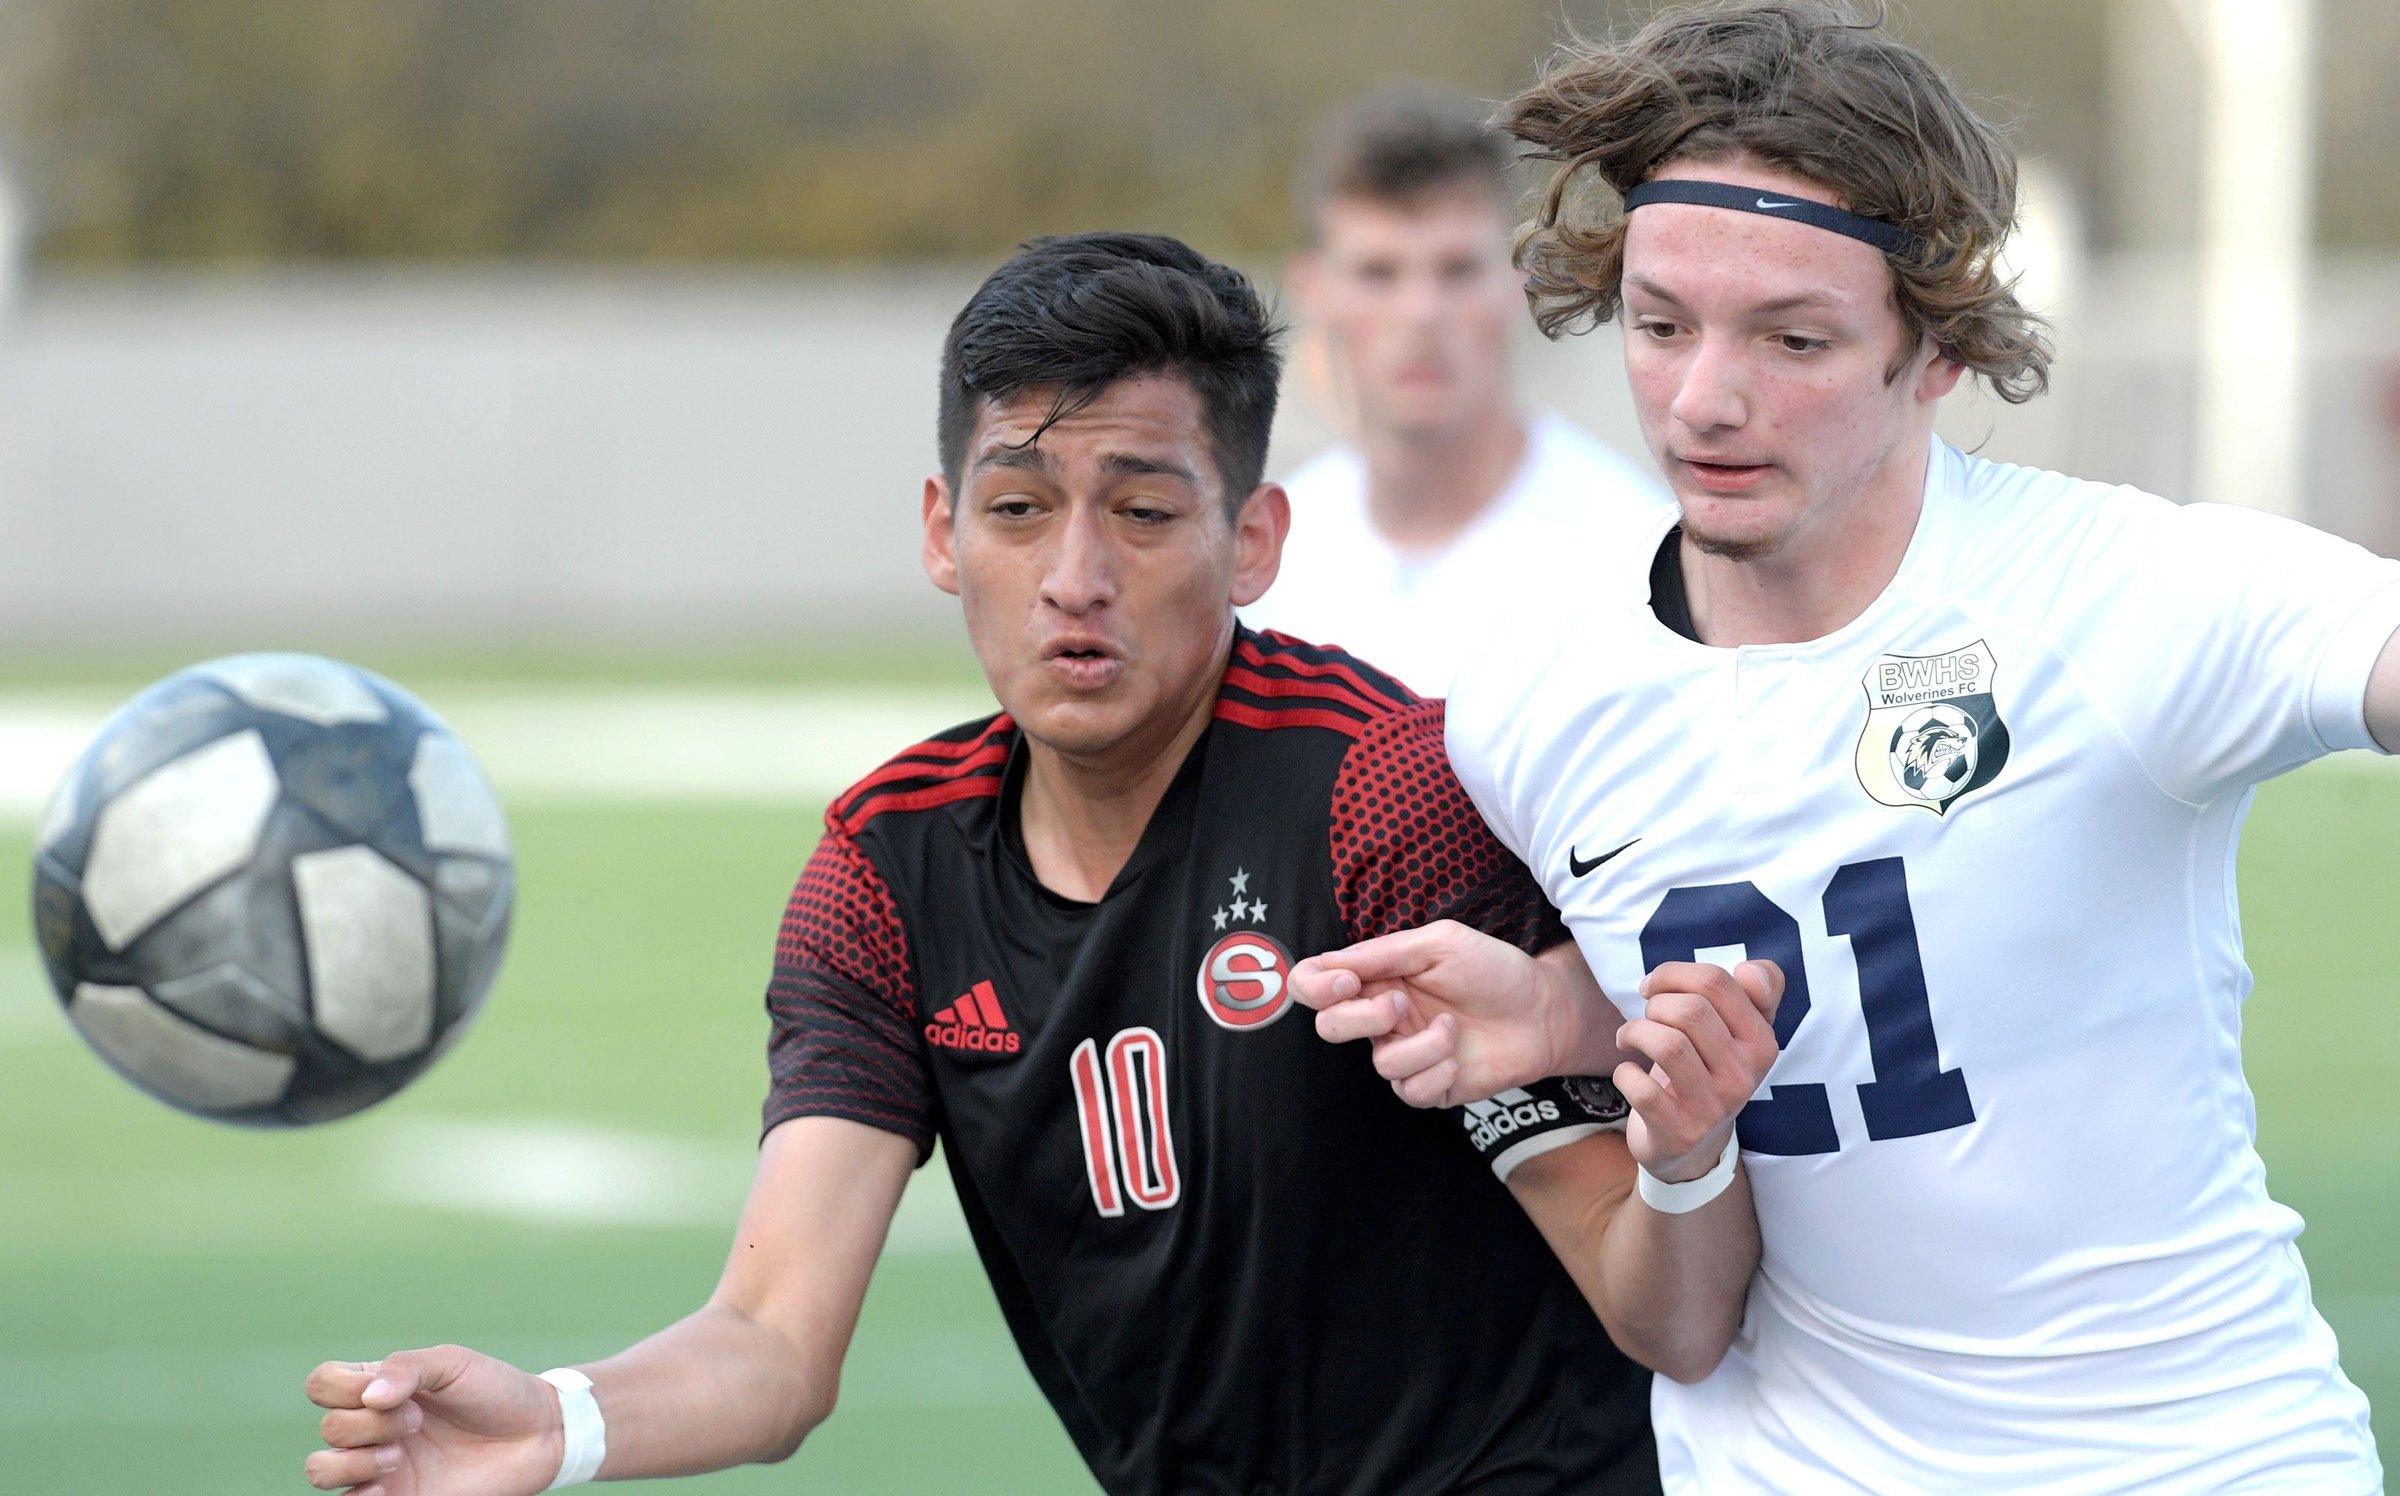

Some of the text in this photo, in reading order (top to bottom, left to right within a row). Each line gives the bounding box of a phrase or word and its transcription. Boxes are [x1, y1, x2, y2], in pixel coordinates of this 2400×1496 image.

[1879, 654, 1980, 691] BWHS
[1881, 682, 1977, 705] Wolverines FC
[1210, 943, 1283, 1011] S
[924, 1021, 1021, 1054] adidas
[1069, 1026, 1181, 1218] 10
[1469, 1099, 1561, 1152] adidas
